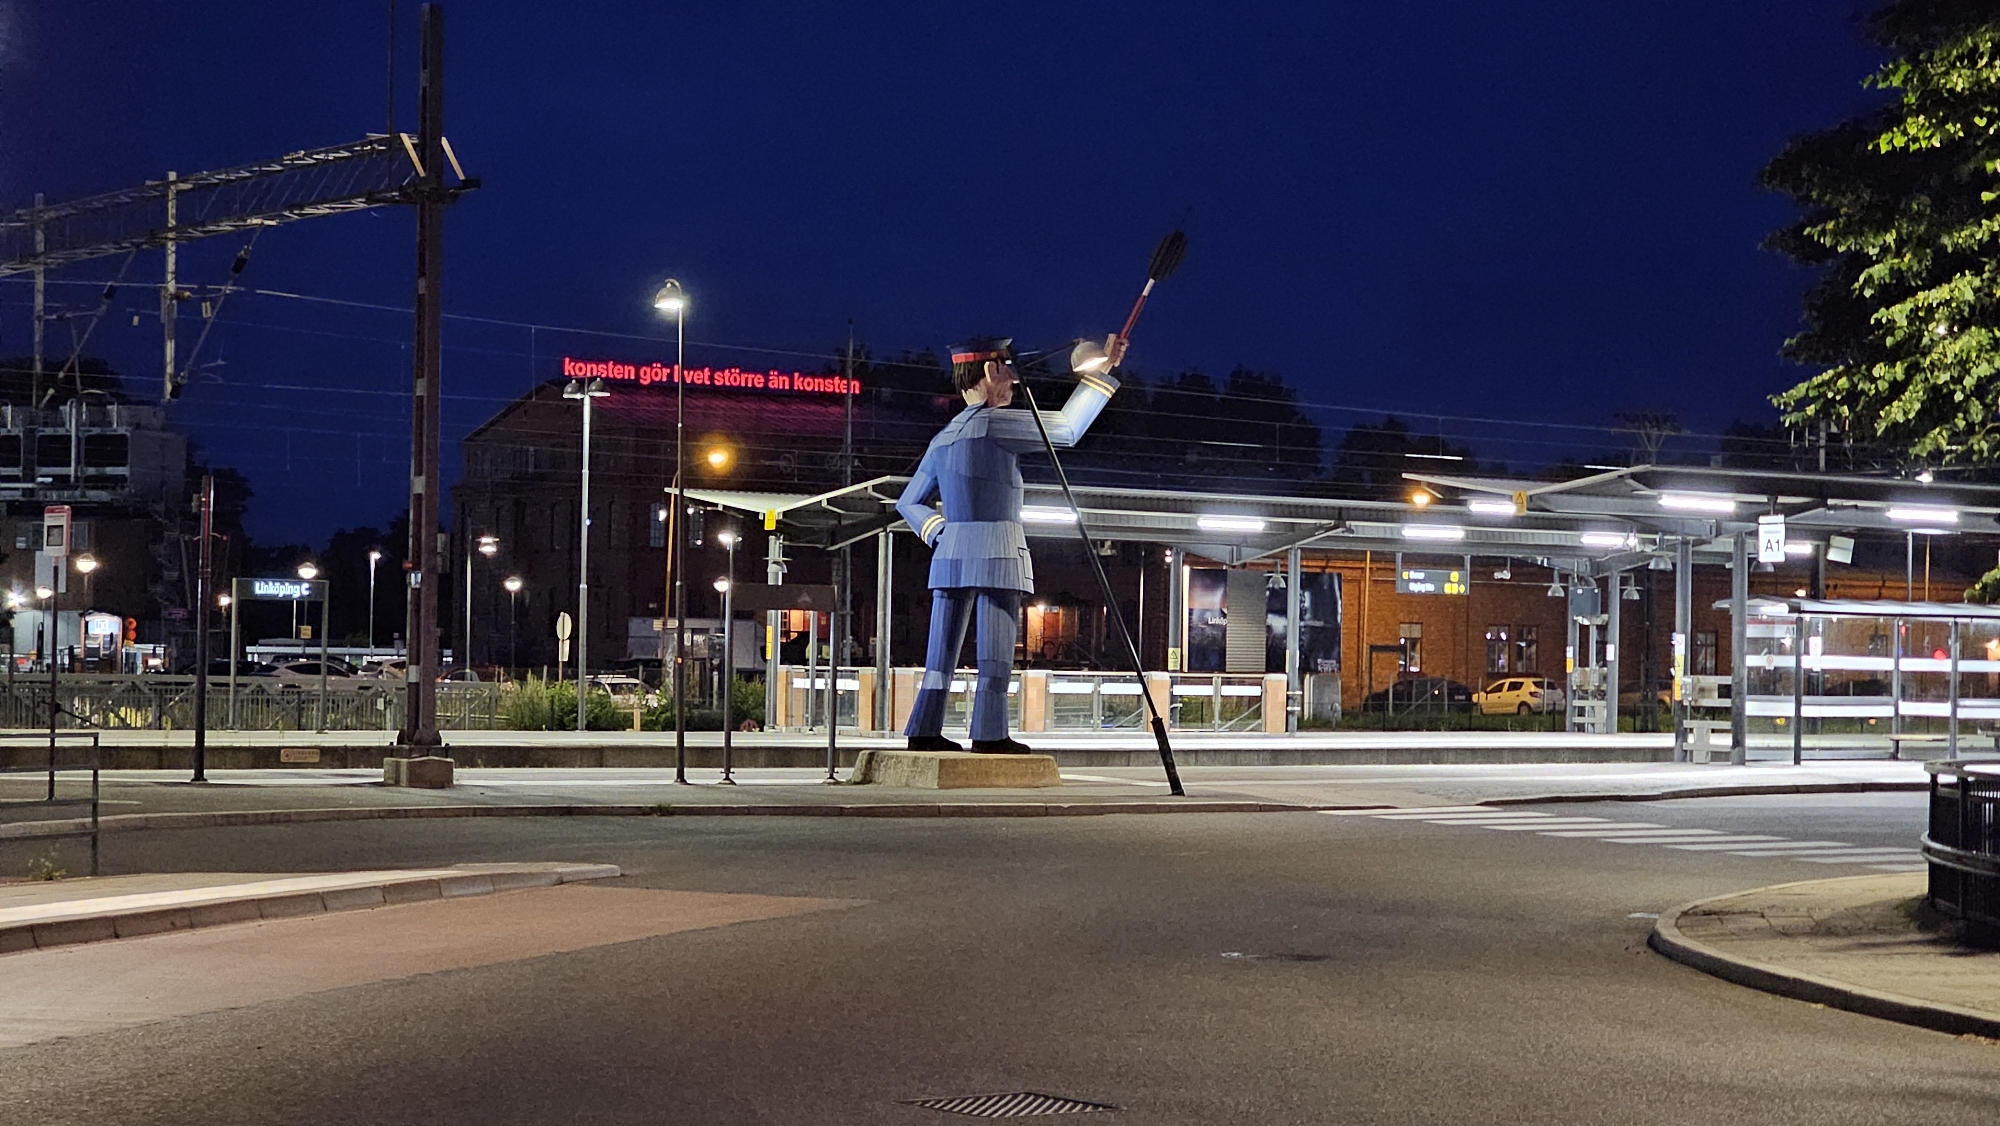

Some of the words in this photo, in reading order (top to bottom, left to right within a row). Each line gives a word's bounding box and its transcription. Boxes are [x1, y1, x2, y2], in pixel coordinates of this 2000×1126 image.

[564, 357, 635, 379] konsten
[639, 363, 670, 385] gör
[673, 364, 711, 385] lvet
[714, 368, 765, 388] större
[768, 370, 790, 390] än
[793, 372, 860, 394] konsten
[1765, 539, 1780, 552] A1
[254, 581, 300, 598] Linköping
[301, 583, 310, 595] C
[1208, 617, 1228, 626] Linköp
